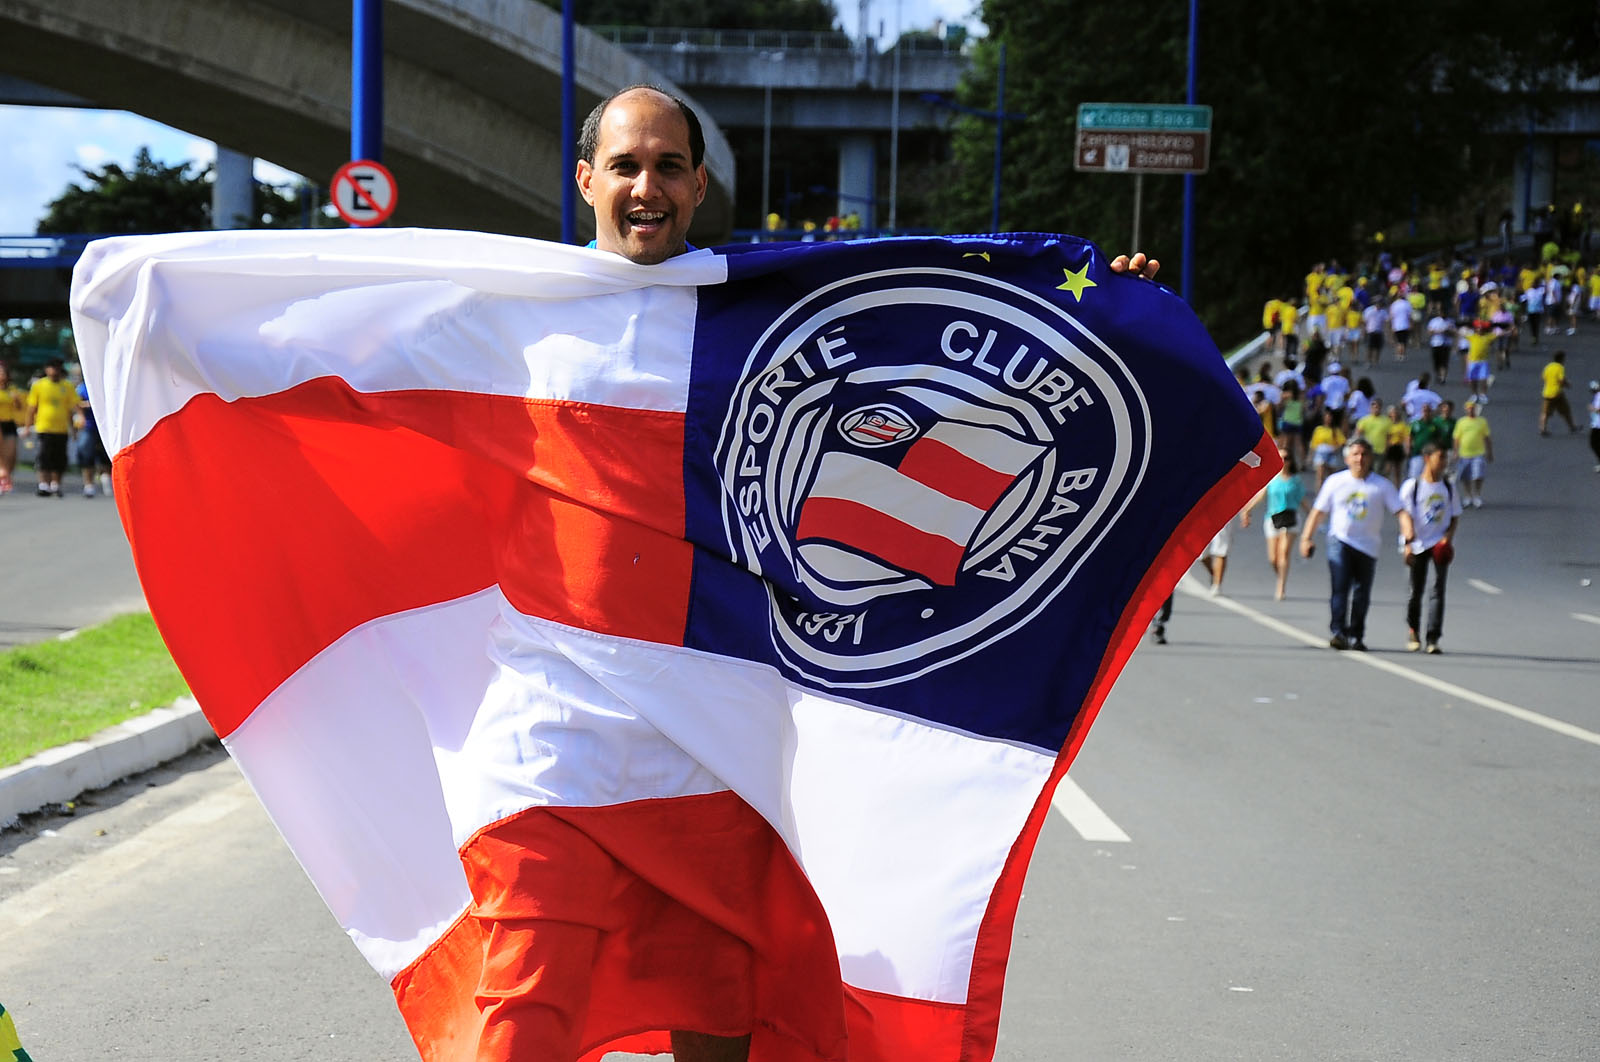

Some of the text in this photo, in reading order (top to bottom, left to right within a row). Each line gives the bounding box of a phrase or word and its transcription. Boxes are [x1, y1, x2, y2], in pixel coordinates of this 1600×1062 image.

[353, 176, 376, 210] E
[940, 320, 1094, 425] CLUBE
[977, 467, 1098, 582] BAHIA
